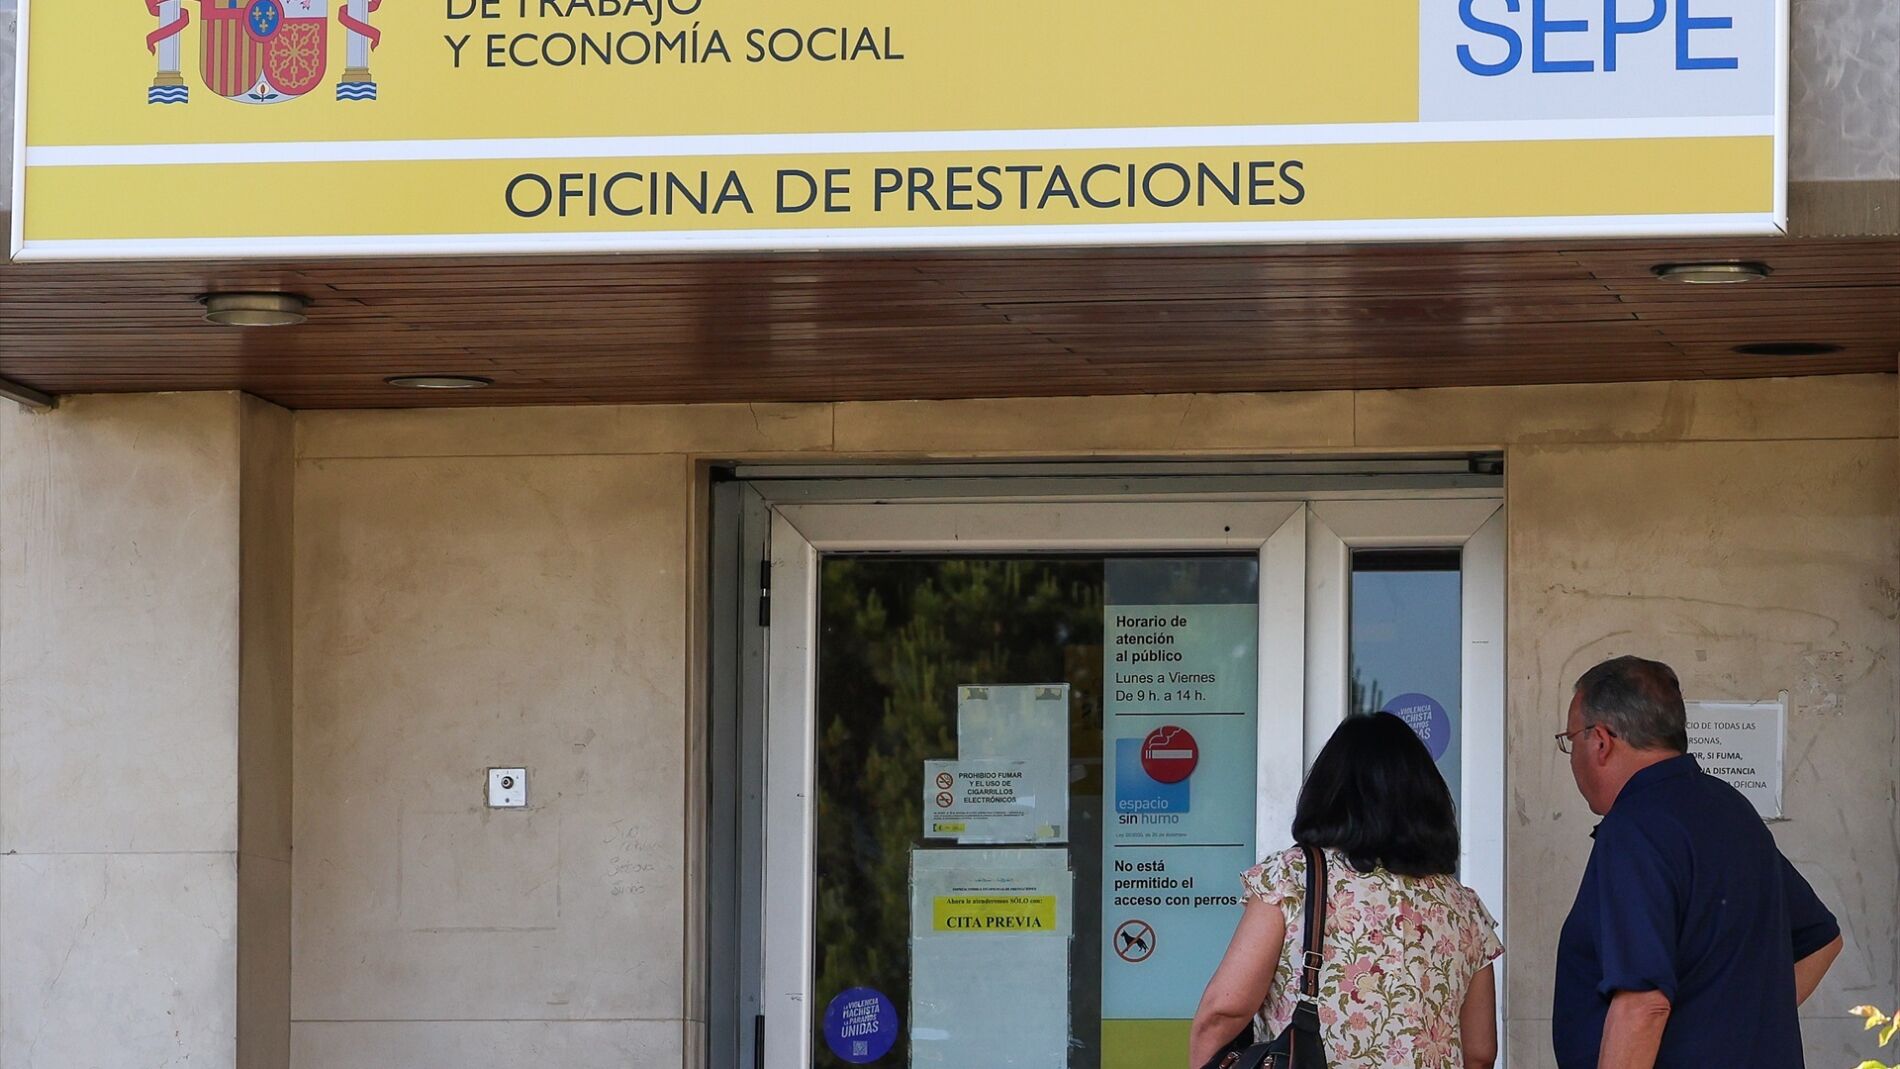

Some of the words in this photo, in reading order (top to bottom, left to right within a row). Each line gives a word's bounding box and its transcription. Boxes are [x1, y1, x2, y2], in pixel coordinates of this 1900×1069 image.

[446, 0, 501, 20] DE
[443, 34, 471, 68] Y
[486, 21, 732, 67] ECONOMÍA
[746, 26, 905, 63] SOCIAL
[1456, 0, 1738, 77] SEPE
[504, 170, 754, 218] OFICINA
[776, 169, 851, 214] DE
[873, 160, 1306, 212] PRESTACIONES
[1116, 615, 1167, 628] Horario
[1170, 615, 1187, 627] de
[1115, 633, 1175, 645] atención
[1115, 650, 1128, 662] al
[1132, 650, 1183, 664] público
[1115, 672, 1153, 684] Lunes
[1157, 674, 1165, 683] a
[1168, 671, 1216, 683] Viernes
[1115, 690, 1133, 701] De
[1137, 689, 1145, 701] 9
[1148, 689, 1160, 701] h.
[1164, 692, 1172, 701] a
[1177, 689, 1191, 701] 14
[1195, 689, 1206, 701] h.
[1401, 711, 1432, 723] ACHISTA
[1701, 721, 1712, 730] DE
[1714, 721, 1740, 730] TODAS
[1742, 721, 1756, 730] LAS
[1688, 736, 1722, 746] RSONAS,
[1707, 751, 1714, 760] SI
[1716, 752, 1743, 761] FUMA,
[1712, 767, 1756, 775] DISTANCIA
[1733, 780, 1767, 789] OFICINA
[1119, 796, 1169, 812] espacio
[1118, 812, 1138, 825] sin
[1141, 812, 1180, 825] humo
[1114, 860, 1133, 872] No
[1136, 859, 1165, 872] está
[1114, 877, 1178, 891] permitido
[1181, 877, 1193, 889] el
[1114, 896, 1161, 906] acceso
[1165, 896, 1190, 906] con
[1194, 896, 1237, 908] perros
[946, 916, 982, 928] CITA
[986, 916, 1041, 928] PREVIA
[842, 1004, 880, 1019] MACHISTA
[841, 1020, 879, 1038] UNIDAS
